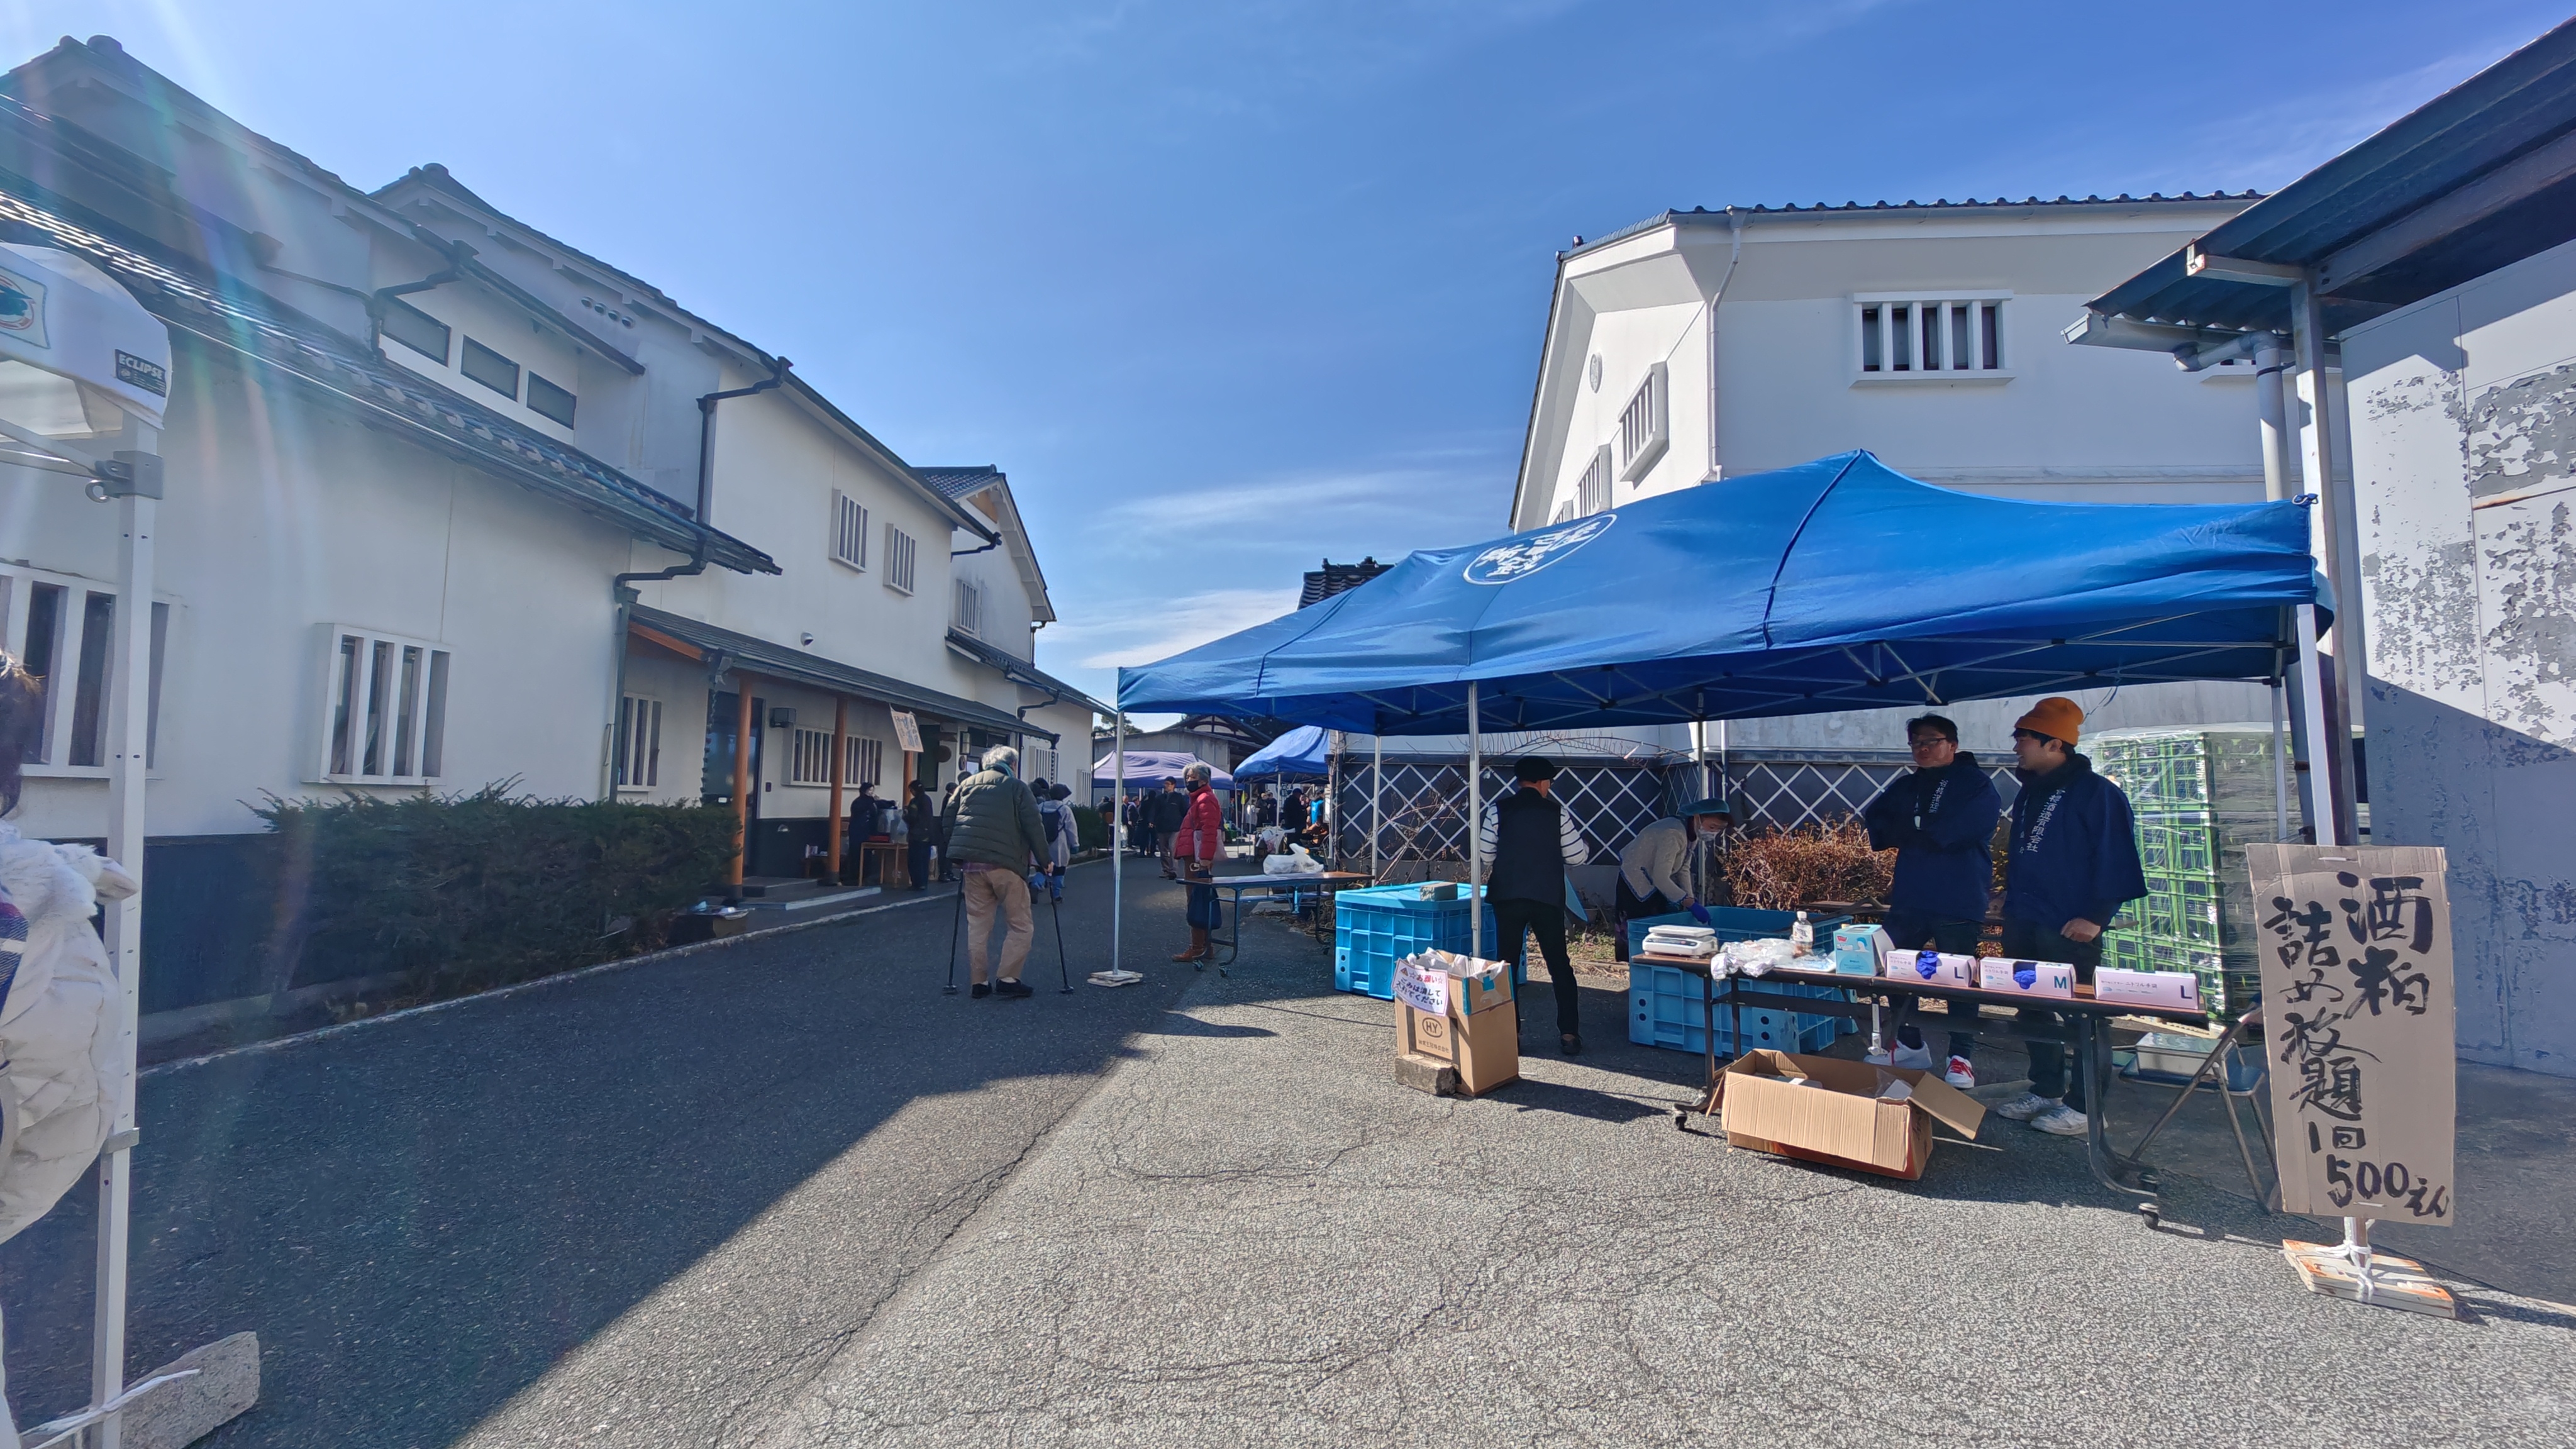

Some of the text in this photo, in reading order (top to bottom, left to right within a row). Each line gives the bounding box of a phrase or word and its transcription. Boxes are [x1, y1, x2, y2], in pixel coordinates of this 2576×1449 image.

[118, 353, 162, 379] ECLIPSE
[2336, 870, 2434, 1018] 酒粕
[1954, 966, 1964, 979] L
[2053, 975, 2067, 989] M
[2180, 985, 2193, 999] L
